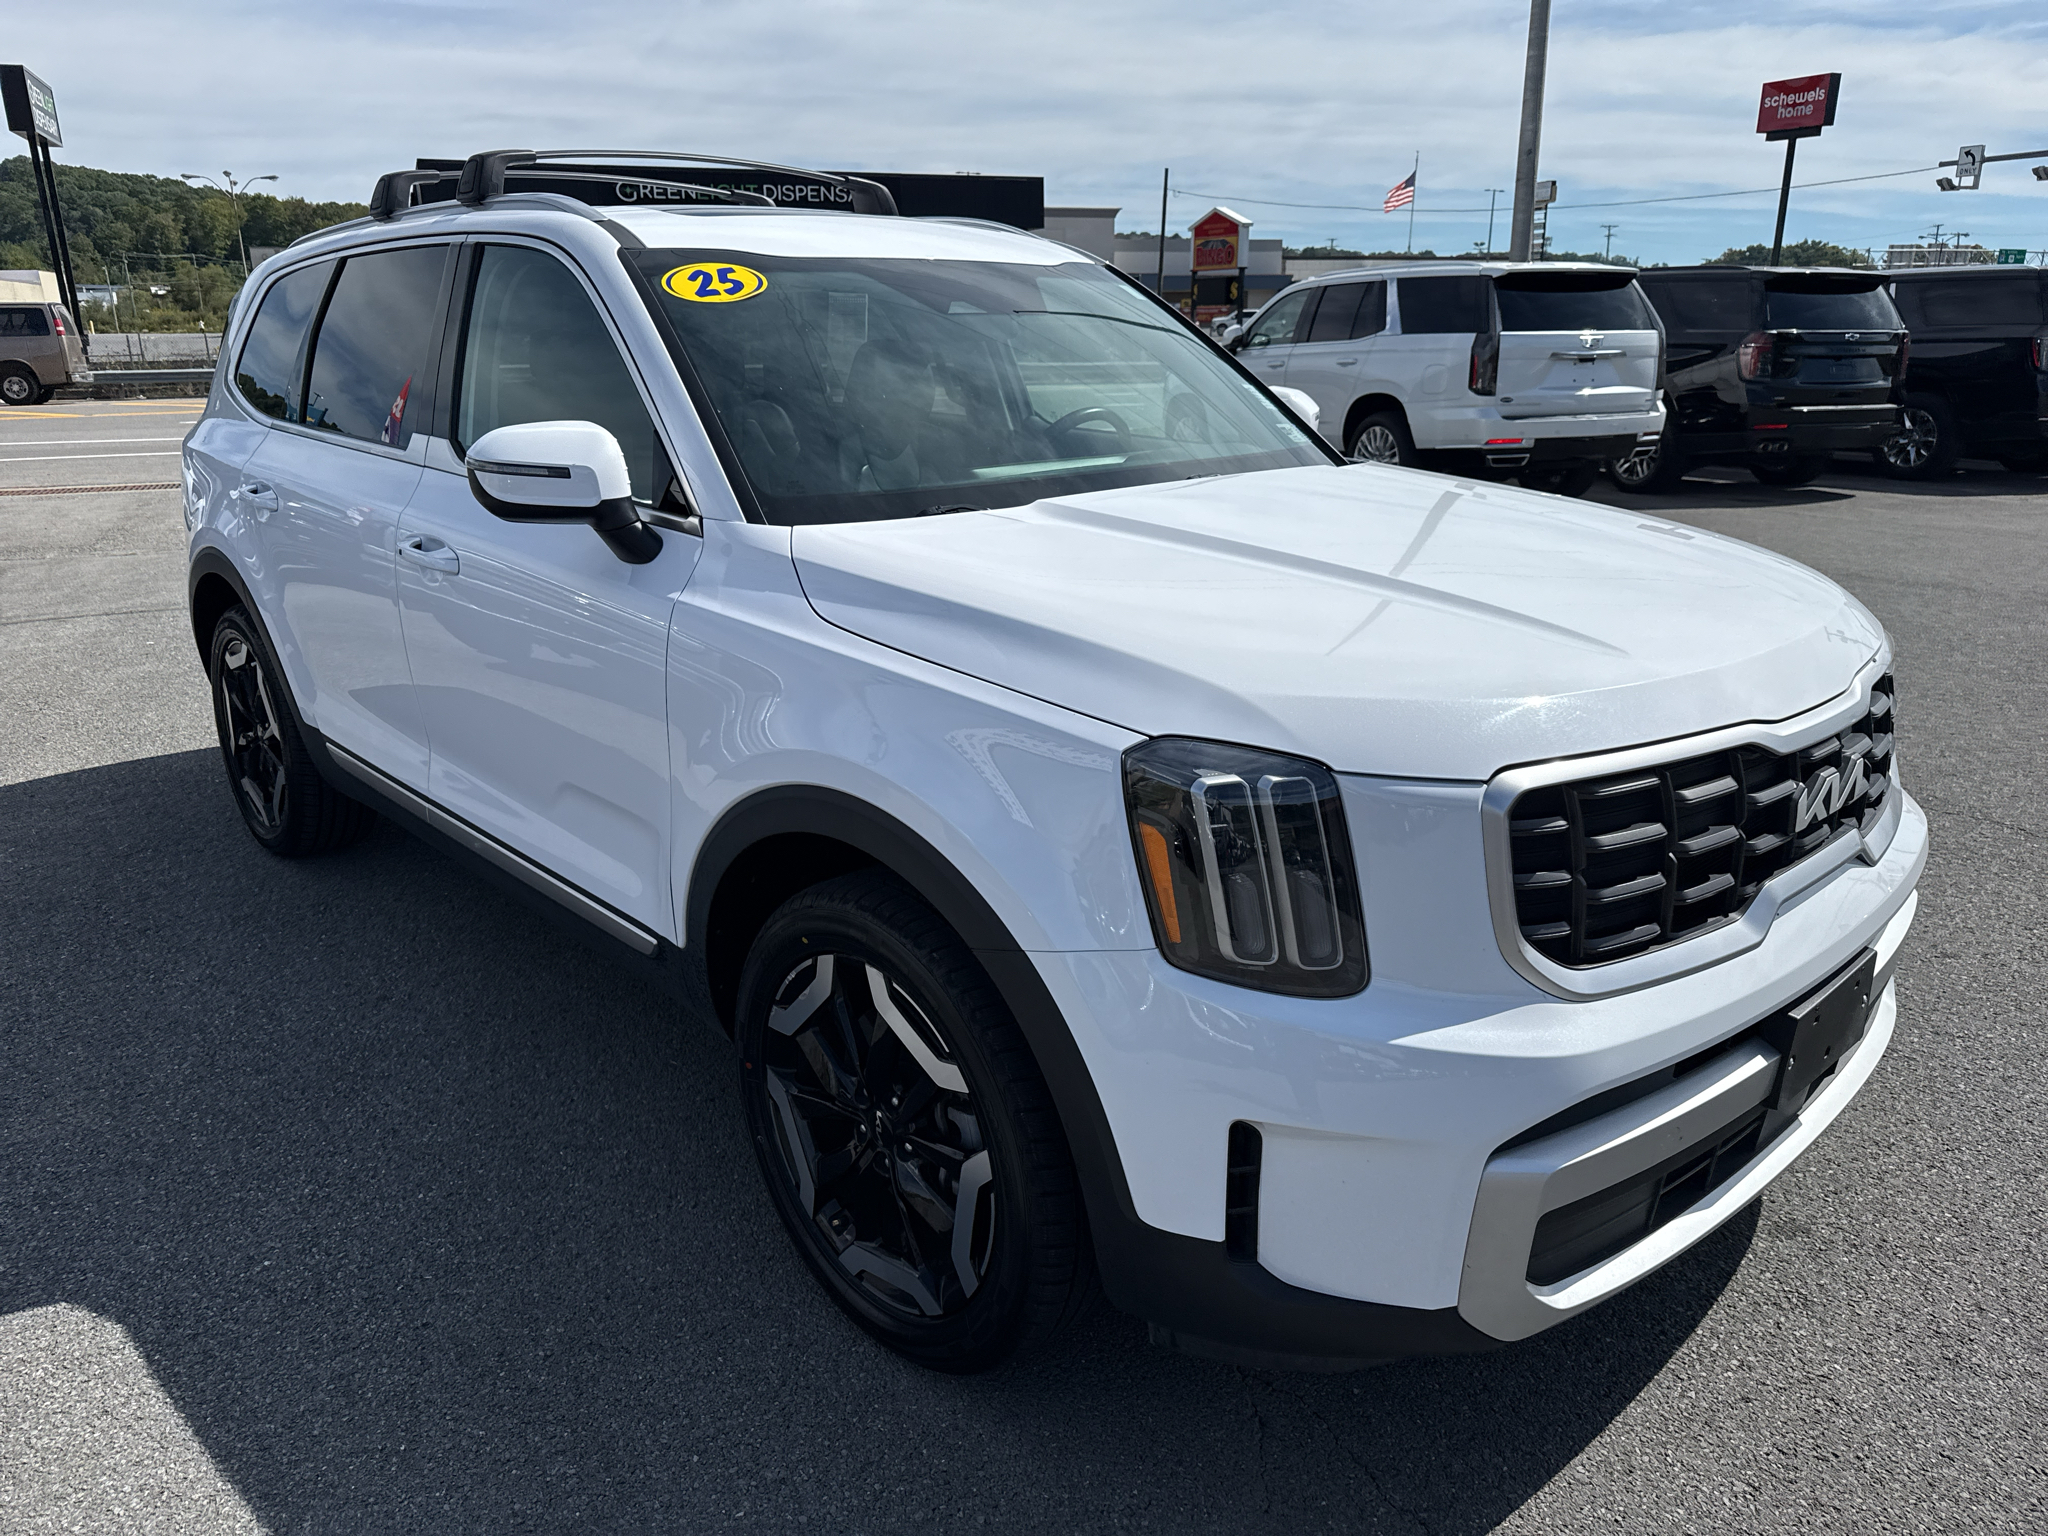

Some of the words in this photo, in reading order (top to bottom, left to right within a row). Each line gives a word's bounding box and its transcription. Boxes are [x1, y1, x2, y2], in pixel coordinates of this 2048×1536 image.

[1764, 87, 1826, 108] schewels
[1777, 104, 1814, 119] home
[1960, 167, 1977, 175] ONLY
[687, 267, 745, 298] 25
